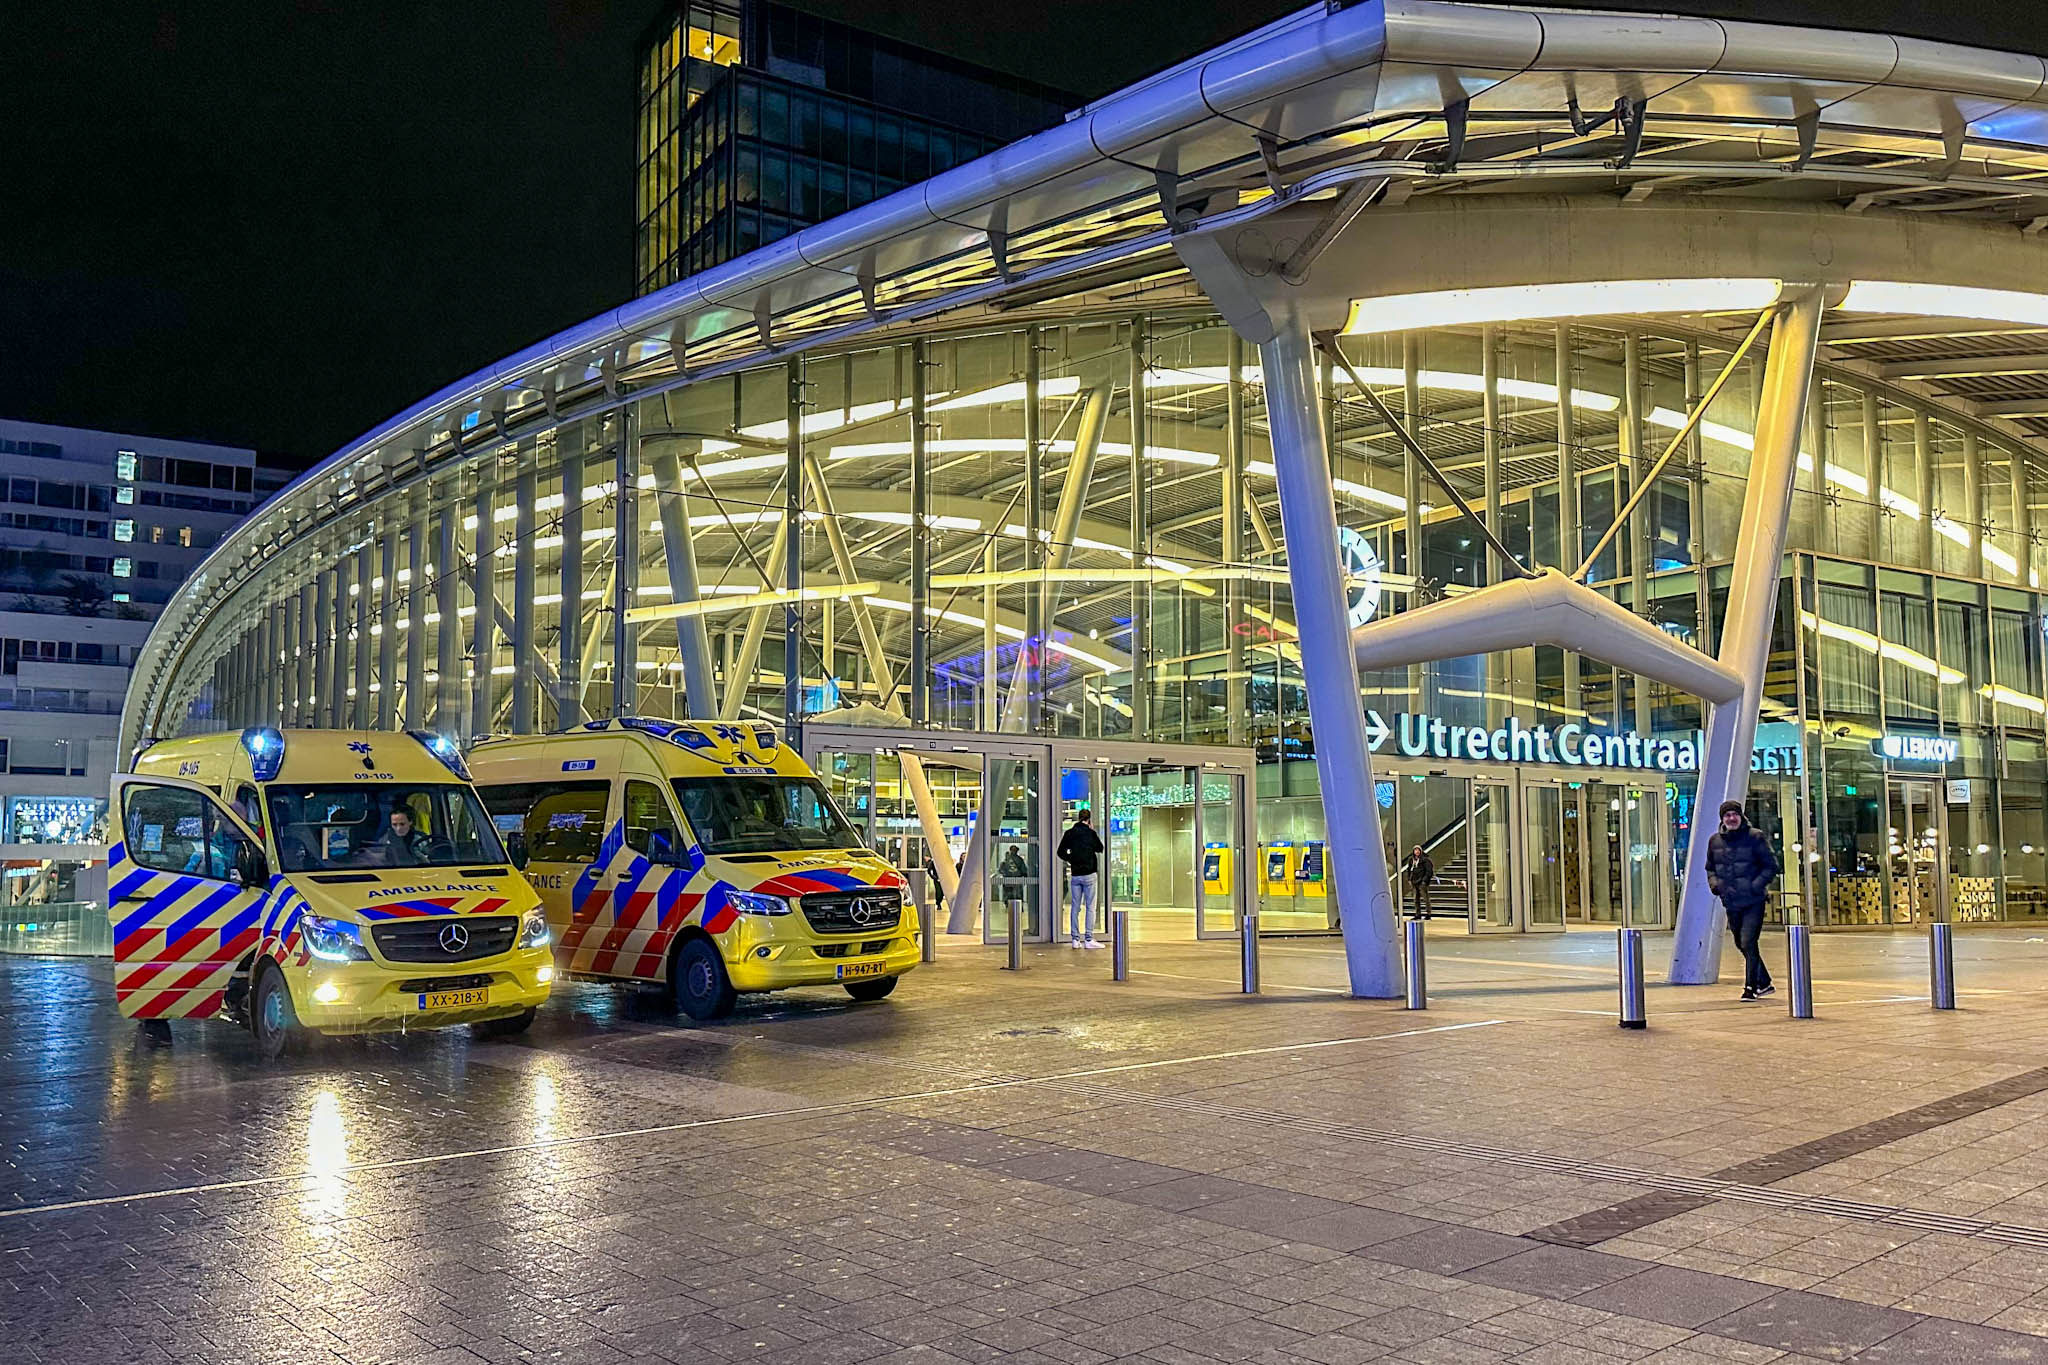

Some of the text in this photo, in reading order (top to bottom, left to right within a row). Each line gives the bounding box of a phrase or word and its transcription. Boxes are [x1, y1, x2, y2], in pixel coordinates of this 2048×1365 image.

[1399, 713, 1704, 770] Utrecht Centraal
[1902, 736, 1957, 762] LEBKOV
[178, 761, 200, 776] 09-105
[368, 884, 500, 899] AMBULANCE
[845, 963, 883, 976] H-947-RT
[432, 991, 483, 1007] XX-218-X
